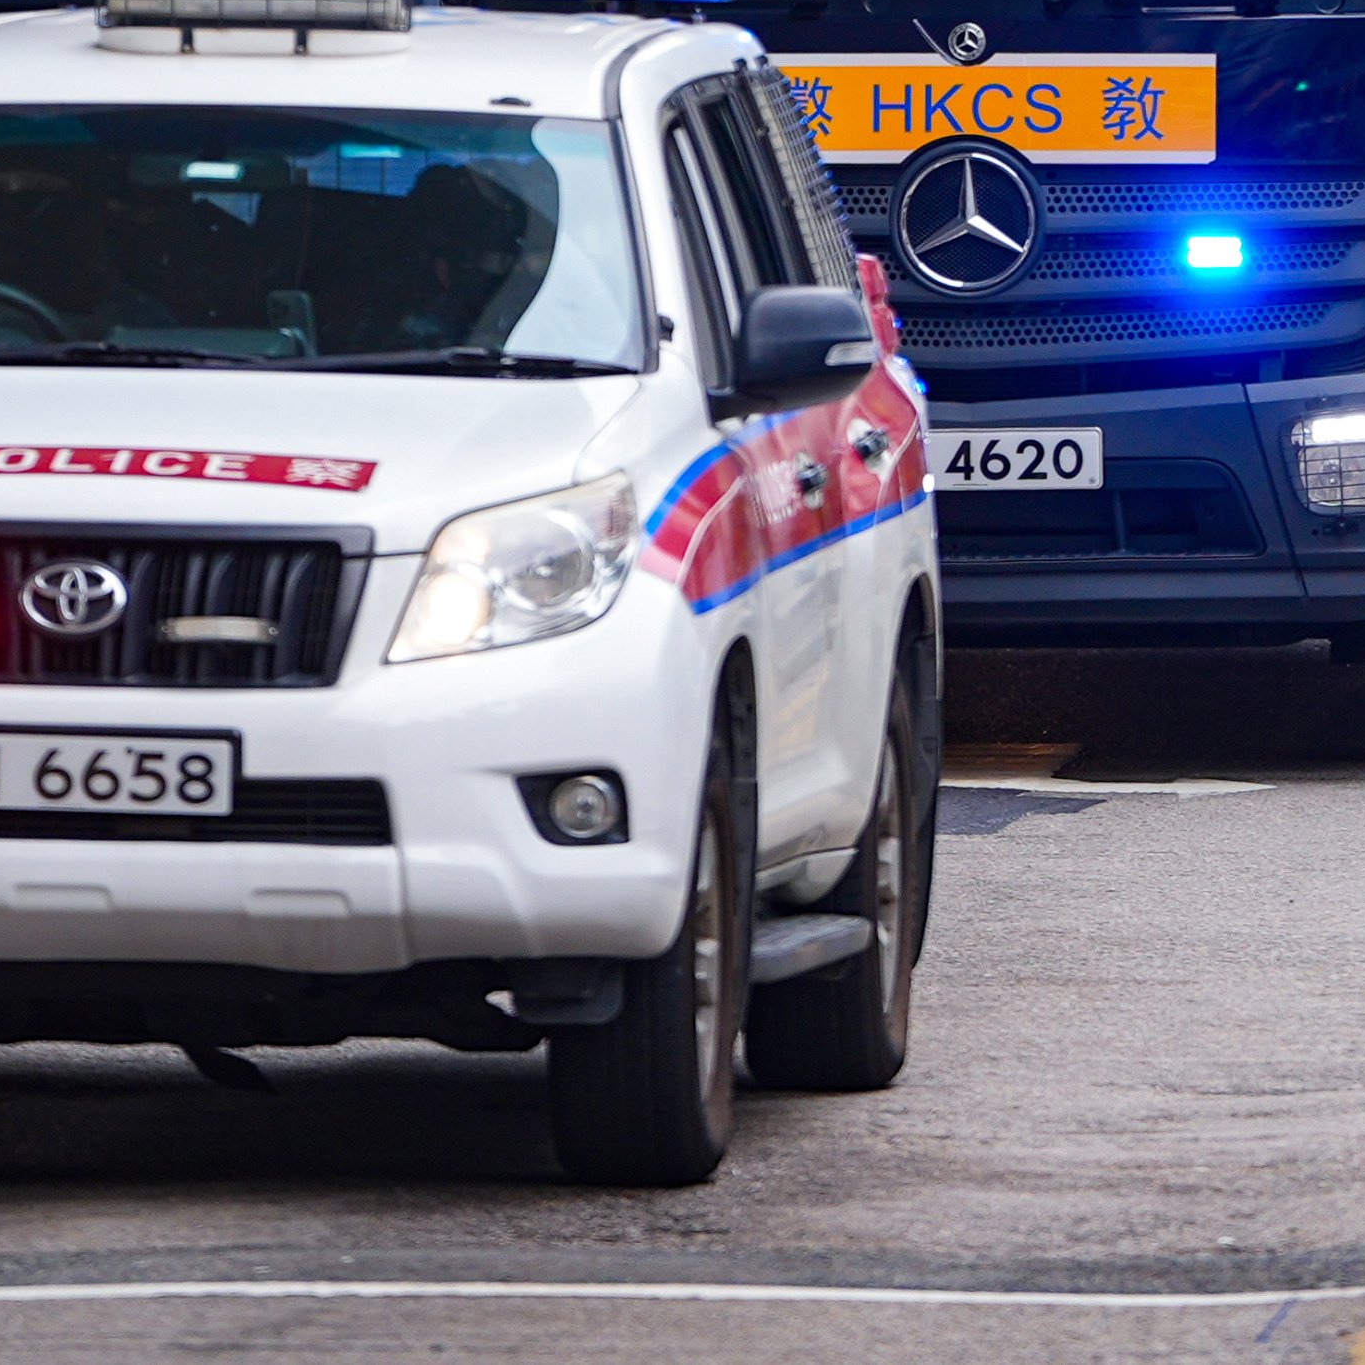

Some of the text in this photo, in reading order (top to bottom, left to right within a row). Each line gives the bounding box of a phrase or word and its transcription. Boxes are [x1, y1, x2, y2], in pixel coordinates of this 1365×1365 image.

[872, 83, 1063, 134] HKCS
[1101, 76, 1165, 140] 教
[944, 439, 1084, 481] 4620
[34, 746, 214, 804] 6658
